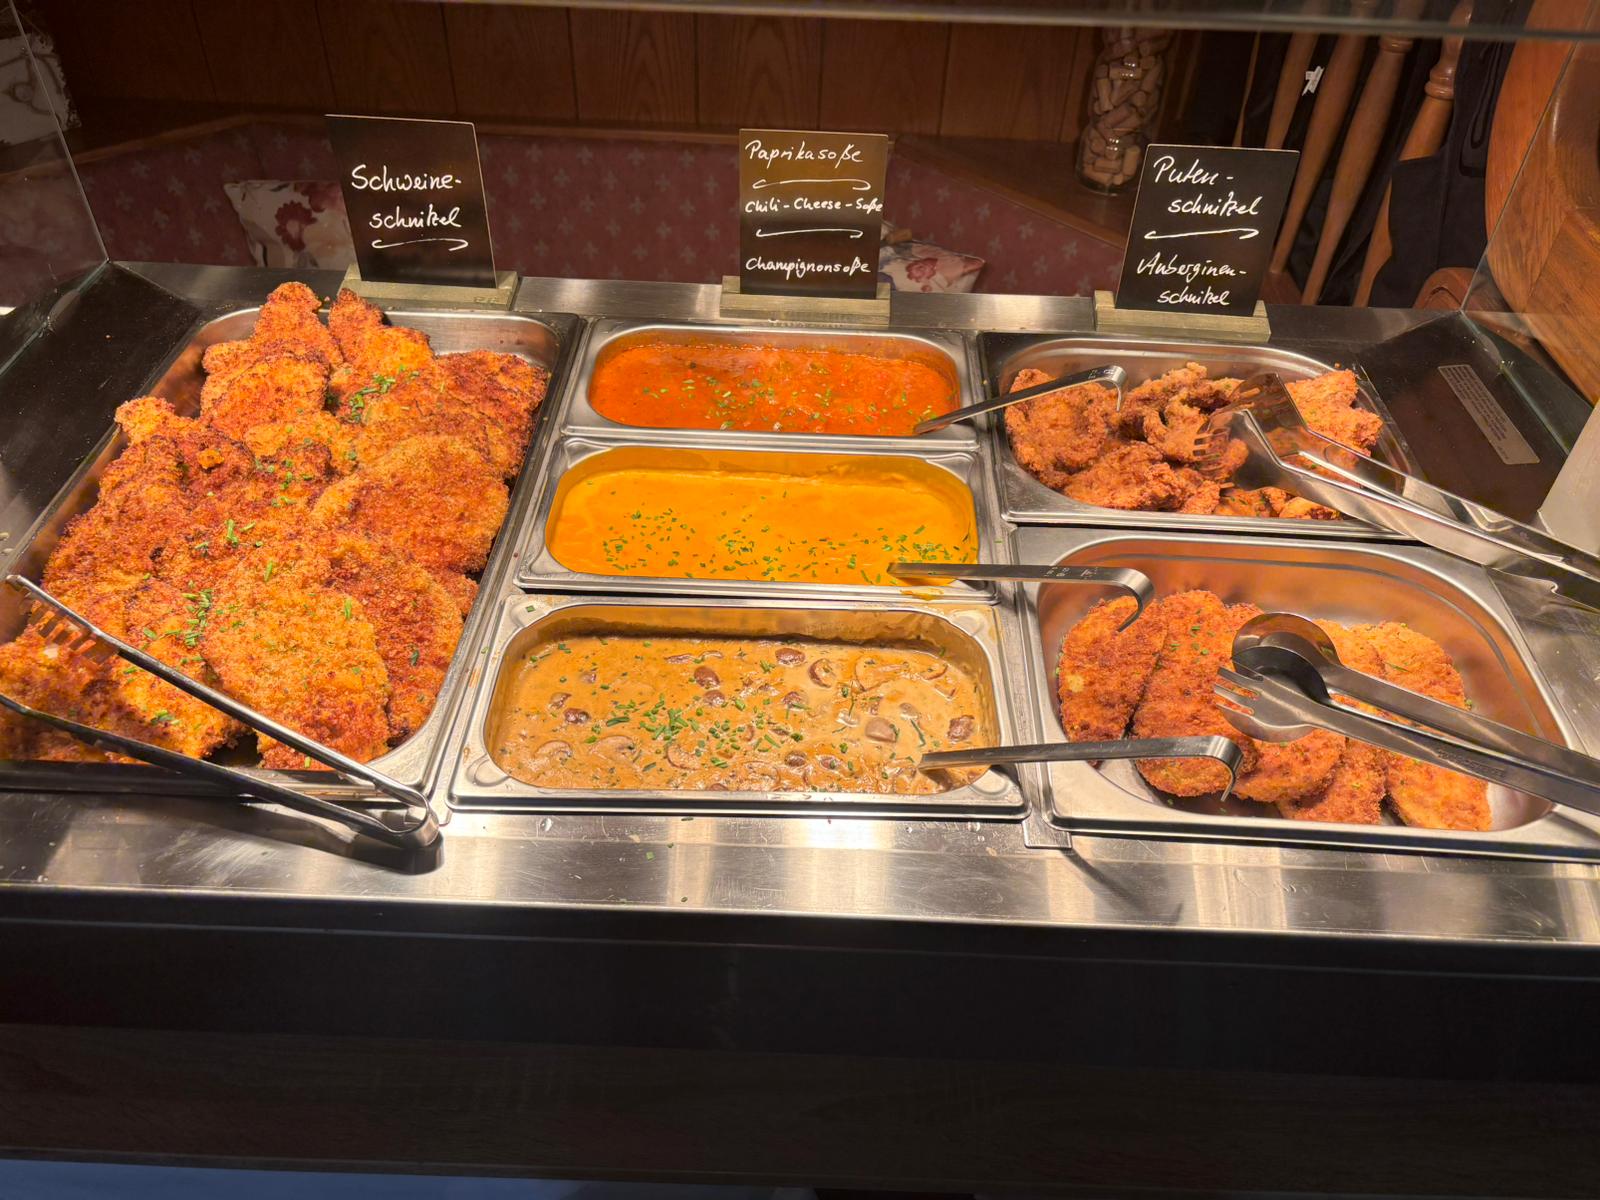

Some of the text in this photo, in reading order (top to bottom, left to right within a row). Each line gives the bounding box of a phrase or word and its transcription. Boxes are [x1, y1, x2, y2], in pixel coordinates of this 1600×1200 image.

[744, 139, 864, 169] Paprikasoße
[351, 164, 462, 192] Schweine-
[369, 203, 462, 229] schnitzel
[1167, 191, 1263, 216] schnitzel
[745, 256, 871, 280] Champignonsoße
[1136, 252, 1247, 283] Auberginen-
[1157, 286, 1230, 305] schnitzel
